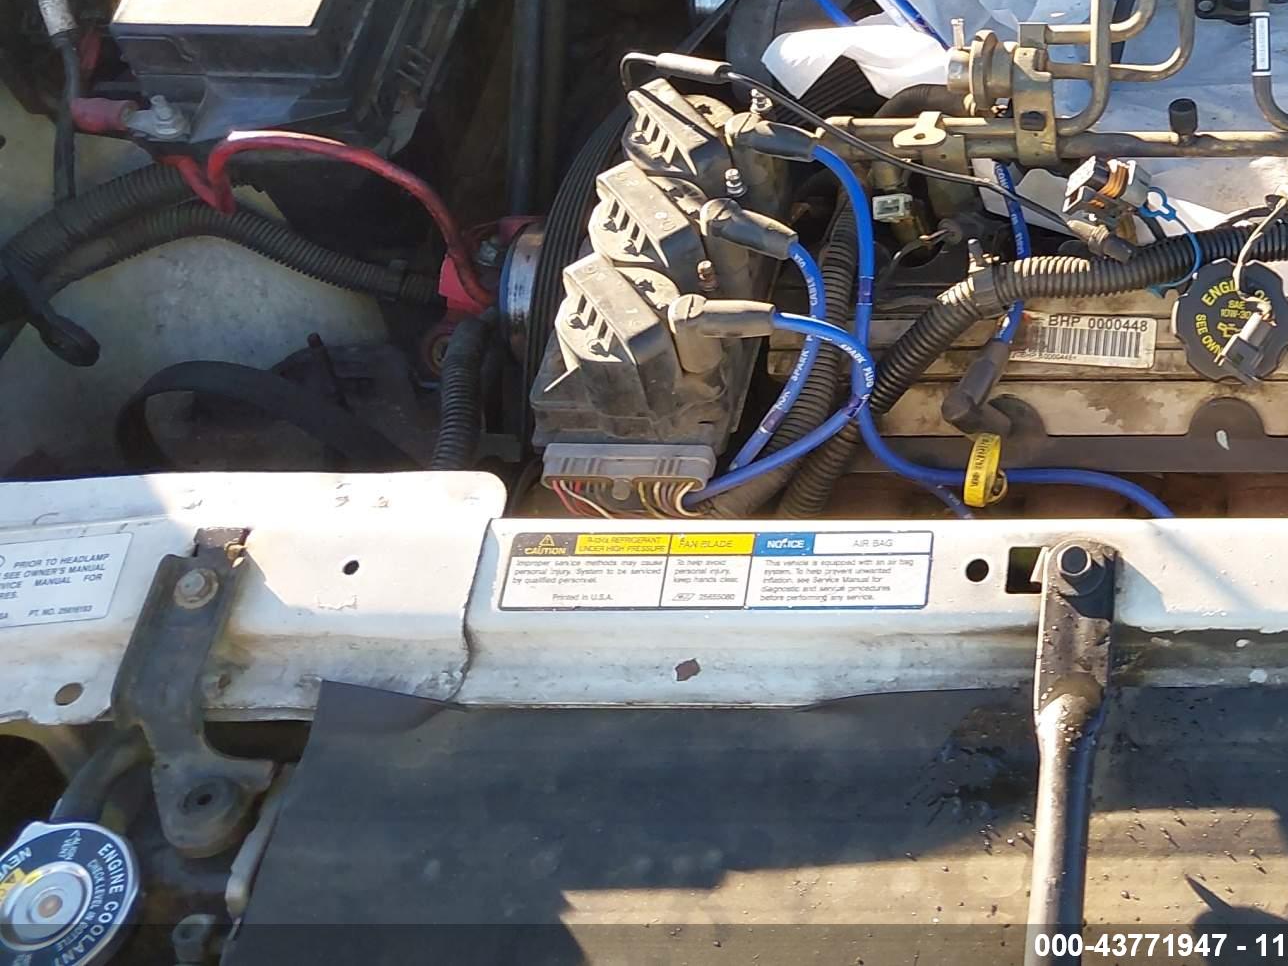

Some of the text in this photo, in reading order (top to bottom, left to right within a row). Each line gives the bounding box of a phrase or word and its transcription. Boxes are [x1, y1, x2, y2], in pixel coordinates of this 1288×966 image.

[1201, 279, 1237, 306] ENGI
[1228, 299, 1246, 309] SAE
[1221, 309, 1252, 320] 10W-30
[1048, 314, 1148, 332] BHP 0000448
[1195, 314, 1209, 335] SEE
[791, 350, 810, 381] SPARK
[525, 545, 566, 555] CAUTION
[679, 539, 734, 548] FAN BLADE
[767, 538, 805, 548] NOTICE
[853, 539, 893, 547] AIR BAG
[13, 554, 110, 568] PRIOR TO HEADLAMP
[3, 564, 106, 580] SEE OWNER'S MANUAL
[34, 577, 72, 586] MANUAL
[83, 574, 103, 582] FOR
[97, 843, 125, 894] ENGINE
[89, 885, 106, 909] LEVEL
